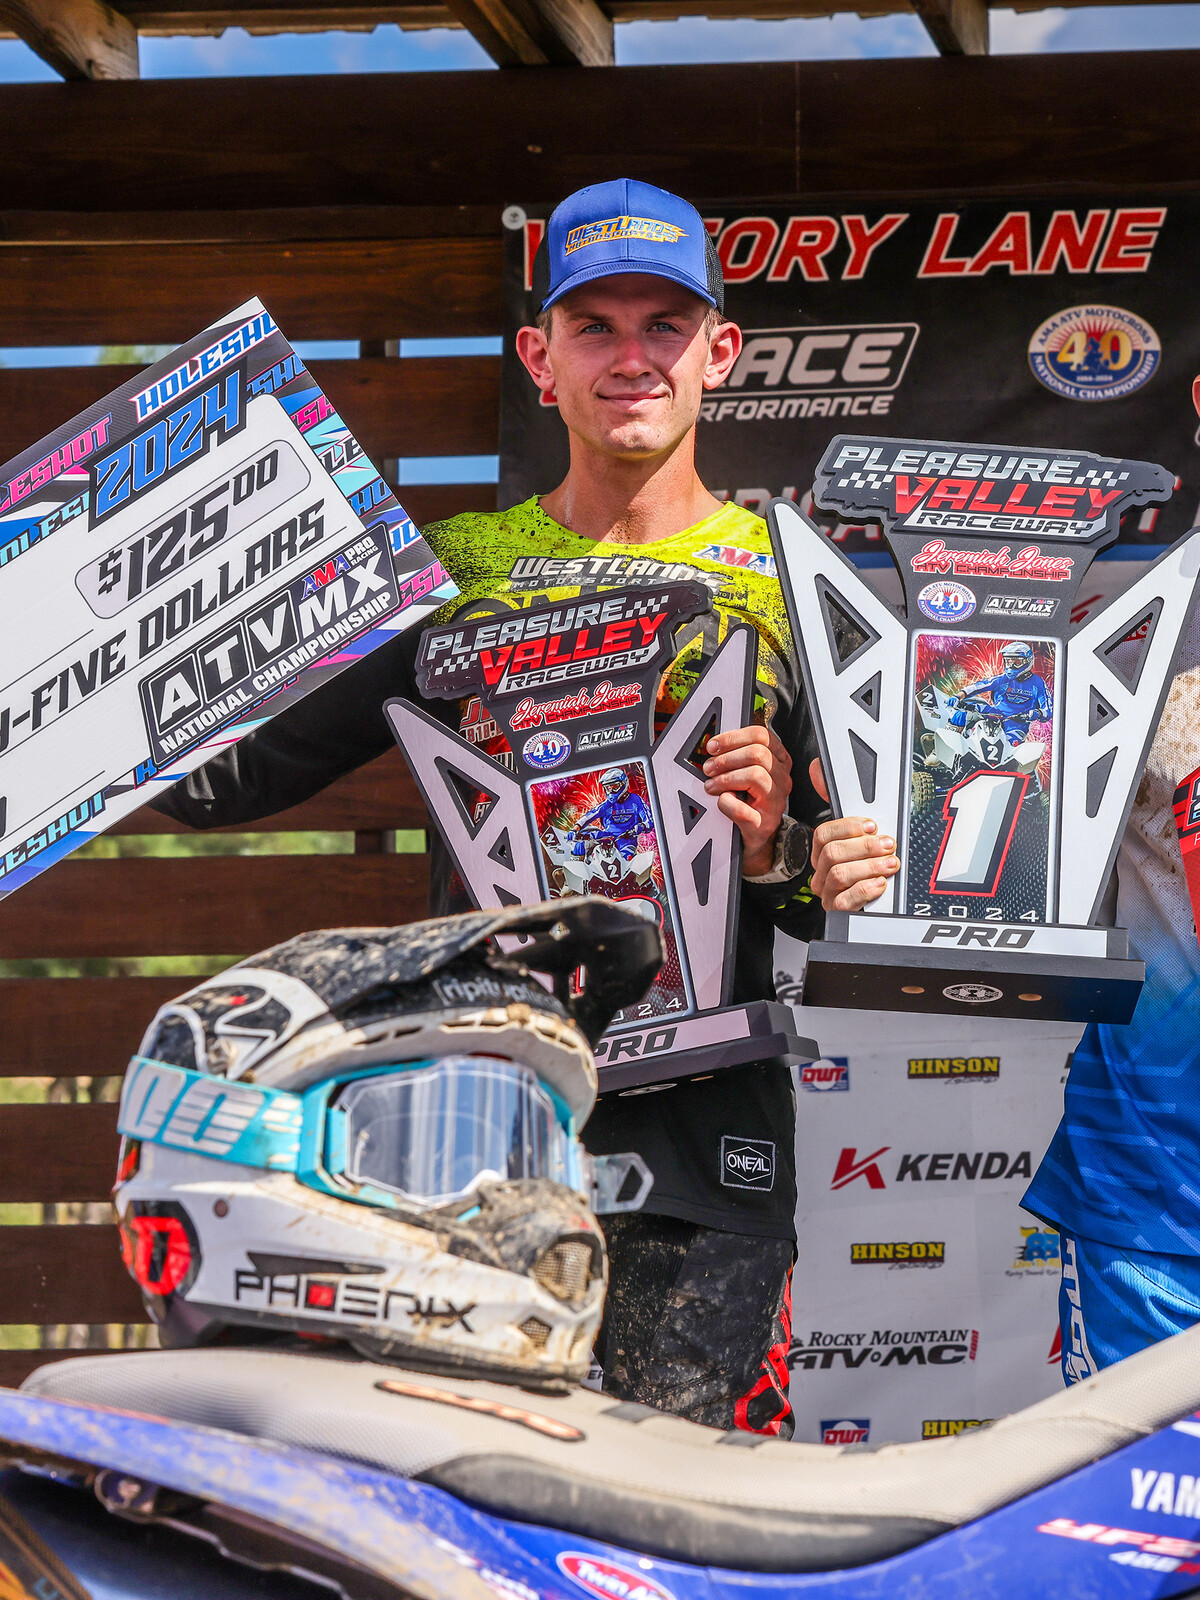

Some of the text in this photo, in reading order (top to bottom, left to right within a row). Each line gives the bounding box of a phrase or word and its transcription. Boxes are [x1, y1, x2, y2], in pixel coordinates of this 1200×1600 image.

[918, 207, 1167, 279] LANE
[1038, 308, 1151, 346] AMA ATV MOTOCROSS
[722, 332, 905, 388] ACE
[1057, 330, 1133, 372] 40
[1035, 353, 1155, 399] NATIONAL CHAMPIONSHIP
[697, 394, 895, 422] RFORMANCE
[94, 369, 241, 518] 2024
[833, 445, 1075, 484] PLEASURE
[895, 474, 1125, 517] VALLEY
[916, 512, 1095, 535] RACEWAY
[345, 536, 375, 561] PRO
[350, 545, 379, 567] RACING
[691, 543, 768, 574] AMA
[912, 540, 1074, 571] Jeremiah Jones
[138, 498, 325, 660] DOLLARS
[302, 552, 352, 600] AMA
[956, 565, 1069, 579] CHAMPIONSHIP
[930, 591, 964, 611] 40
[426, 597, 628, 661] PLEASURE
[479, 613, 668, 685] VALLEY
[159, 591, 392, 755] NATIONAL CHAMPIONSHIP
[506, 647, 651, 690] RACEWAY
[510, 687, 590, 725] Jeremiah
[589, 680, 642, 708] Jones
[922, 692, 933, 704] 2
[533, 739, 561, 759] 40
[986, 745, 999, 761] 2
[545, 833, 556, 845] 2
[932, 772, 1025, 892] 1
[608, 864, 620, 880] 2
[913, 903, 1040, 922] 2024
[921, 923, 1035, 949] PRO
[801, 1066, 848, 1084] DWT
[908, 1057, 1000, 1074] HINSON
[896, 1151, 1032, 1182] KENDA
[851, 1242, 945, 1259] HINSON
[235, 1267, 478, 1333] PHOENIX
[809, 1328, 968, 1347] ROCKY MOUNTAIN
